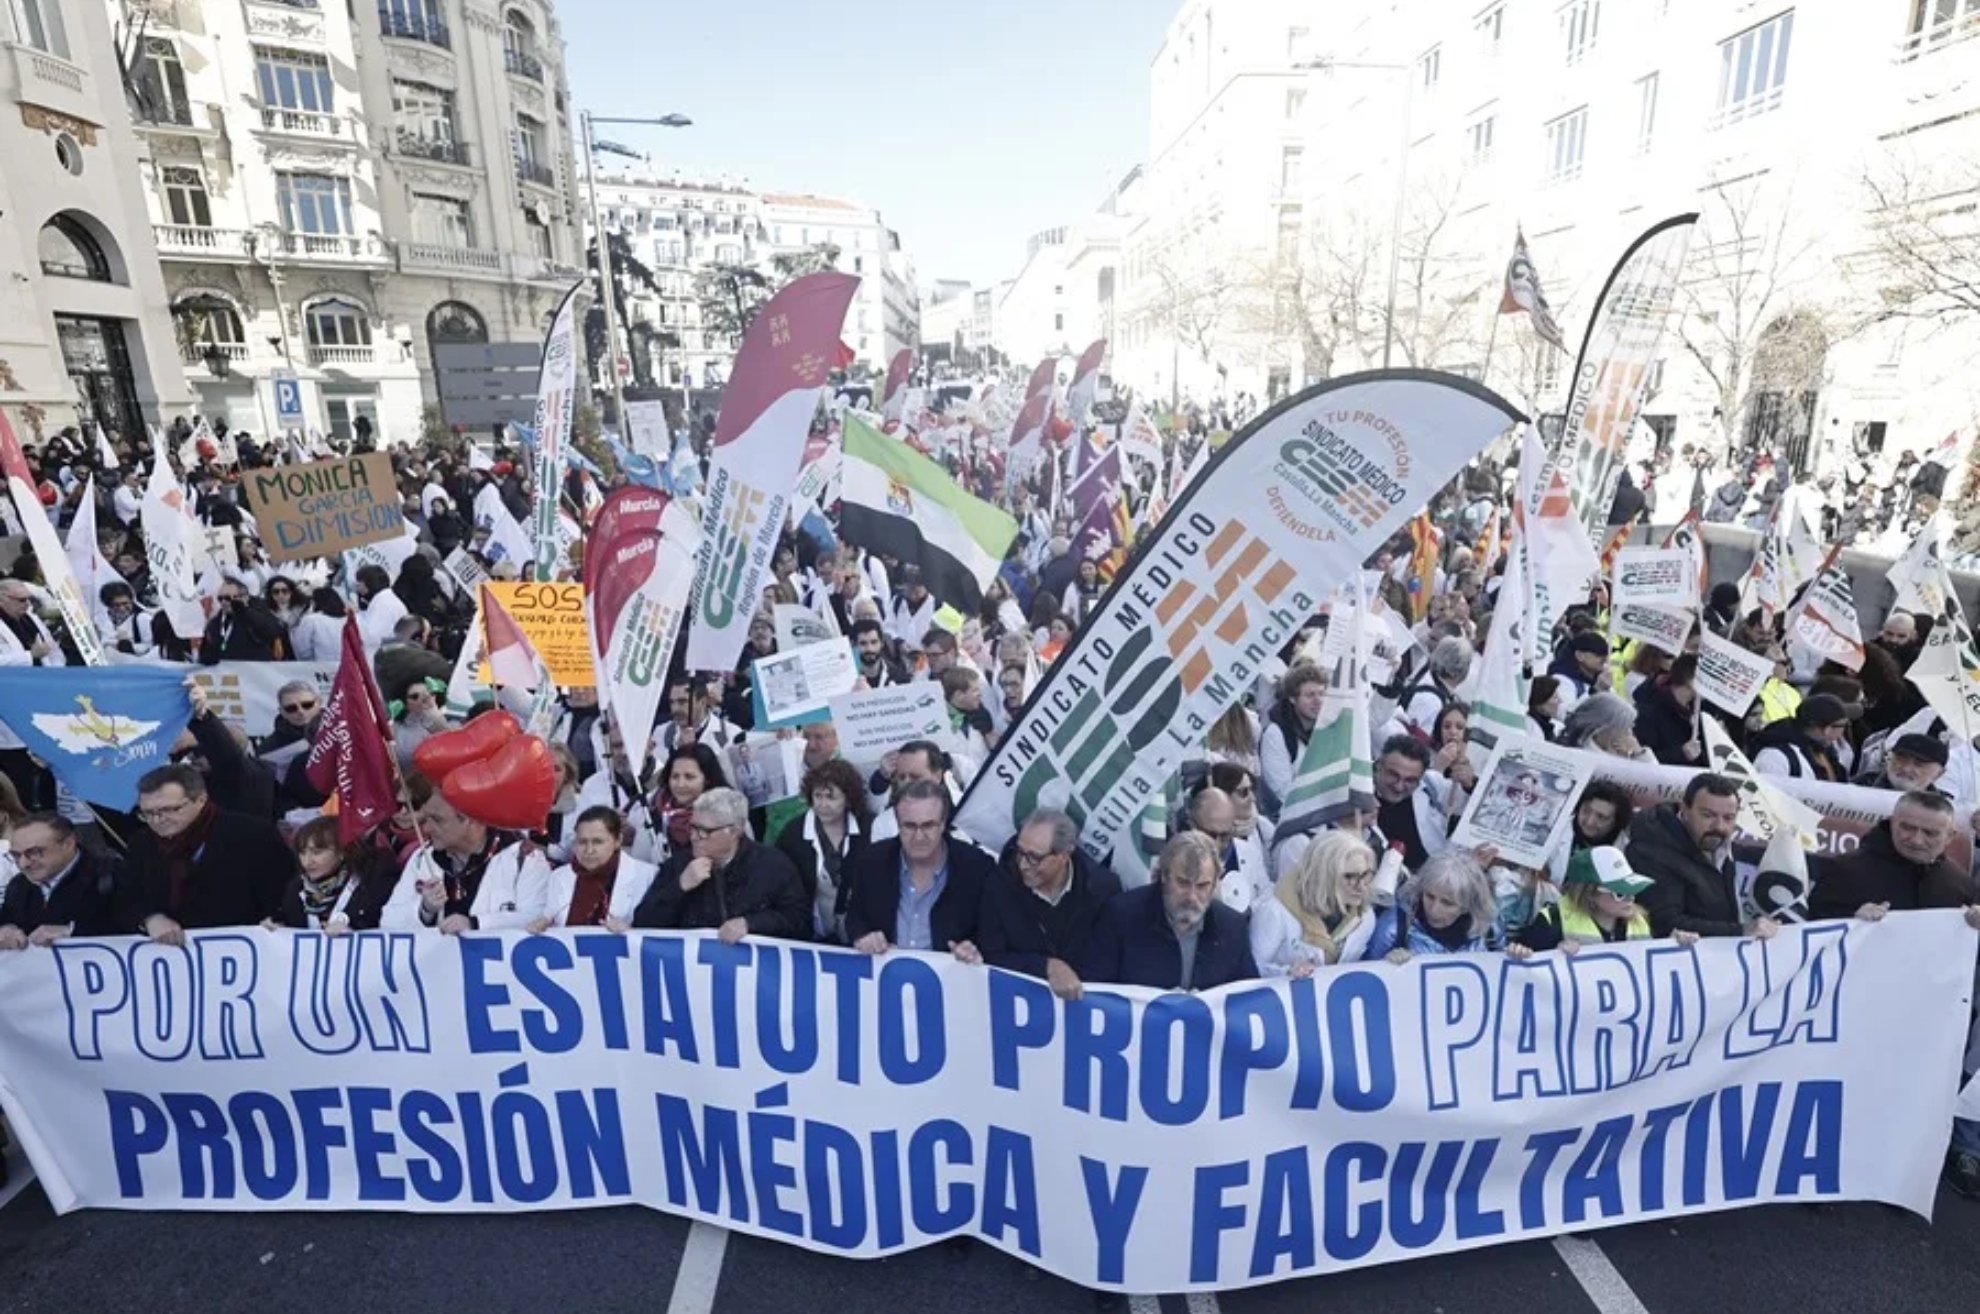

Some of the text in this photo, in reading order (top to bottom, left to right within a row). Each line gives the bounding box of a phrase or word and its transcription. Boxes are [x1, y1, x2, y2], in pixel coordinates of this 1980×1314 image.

[279, 384, 293, 411] P
[1325, 410, 1348, 424] TU
[256, 459, 368, 504] MONICA
[1280, 439, 1390, 528] CESM
[1302, 419, 1406, 505] SINDICATO MÉDICO
[276, 502, 402, 548] DIMISION
[620, 498, 660, 514] Murcia
[706, 468, 729, 537] Médico
[755, 548, 768, 567] de
[763, 493, 785, 546] Murcia
[1321, 500, 1358, 535] Mancha
[617, 538, 654, 563] Murcia
[703, 480, 765, 629] CESM
[511, 584, 582, 611] SOS
[996, 511, 1217, 788] SINDICATO MÉDICO
[1012, 517, 1298, 834] CESM
[1087, 776, 1151, 858] astilla
[1168, 711, 1205, 749] La
[1203, 589, 1314, 705] Mancha
[54, 924, 1849, 1126] POR UN ESTATUTO PROPIO PARA LA
[104, 1061, 1843, 1284] PROFESIÓN MÉDICA Y FACULTATIVA
